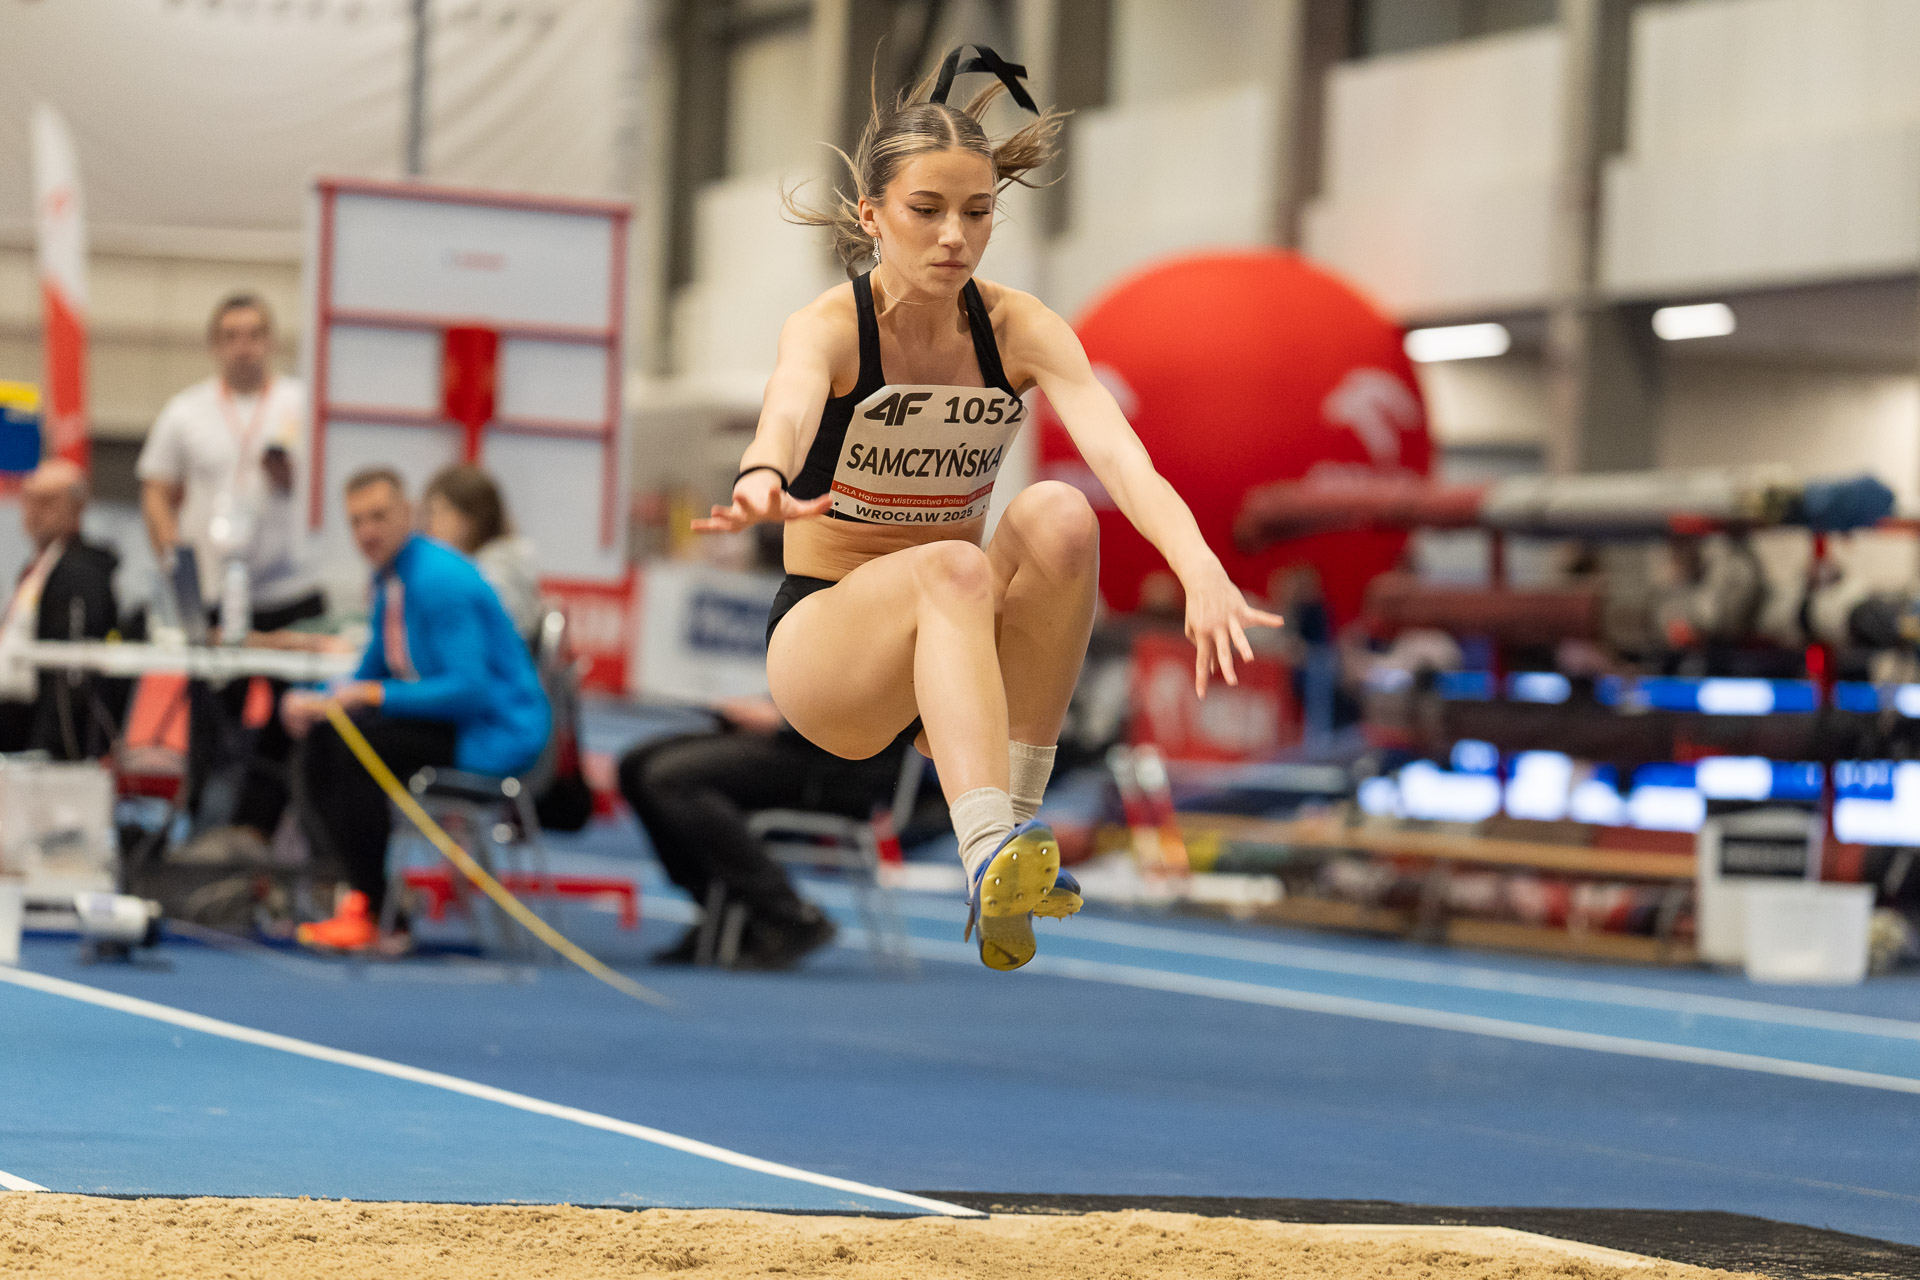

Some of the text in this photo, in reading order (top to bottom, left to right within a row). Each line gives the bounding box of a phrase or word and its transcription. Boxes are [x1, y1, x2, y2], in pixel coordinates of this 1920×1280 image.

[864, 392, 933, 426] 4F
[944, 396, 1023, 425] 1052
[846, 442, 1004, 477] SAMCZYŃSKA
[836, 484, 967, 506] PZLA Halowe Mistrzostwa Polski
[855, 504, 973, 522] WROCŁAW 2025
